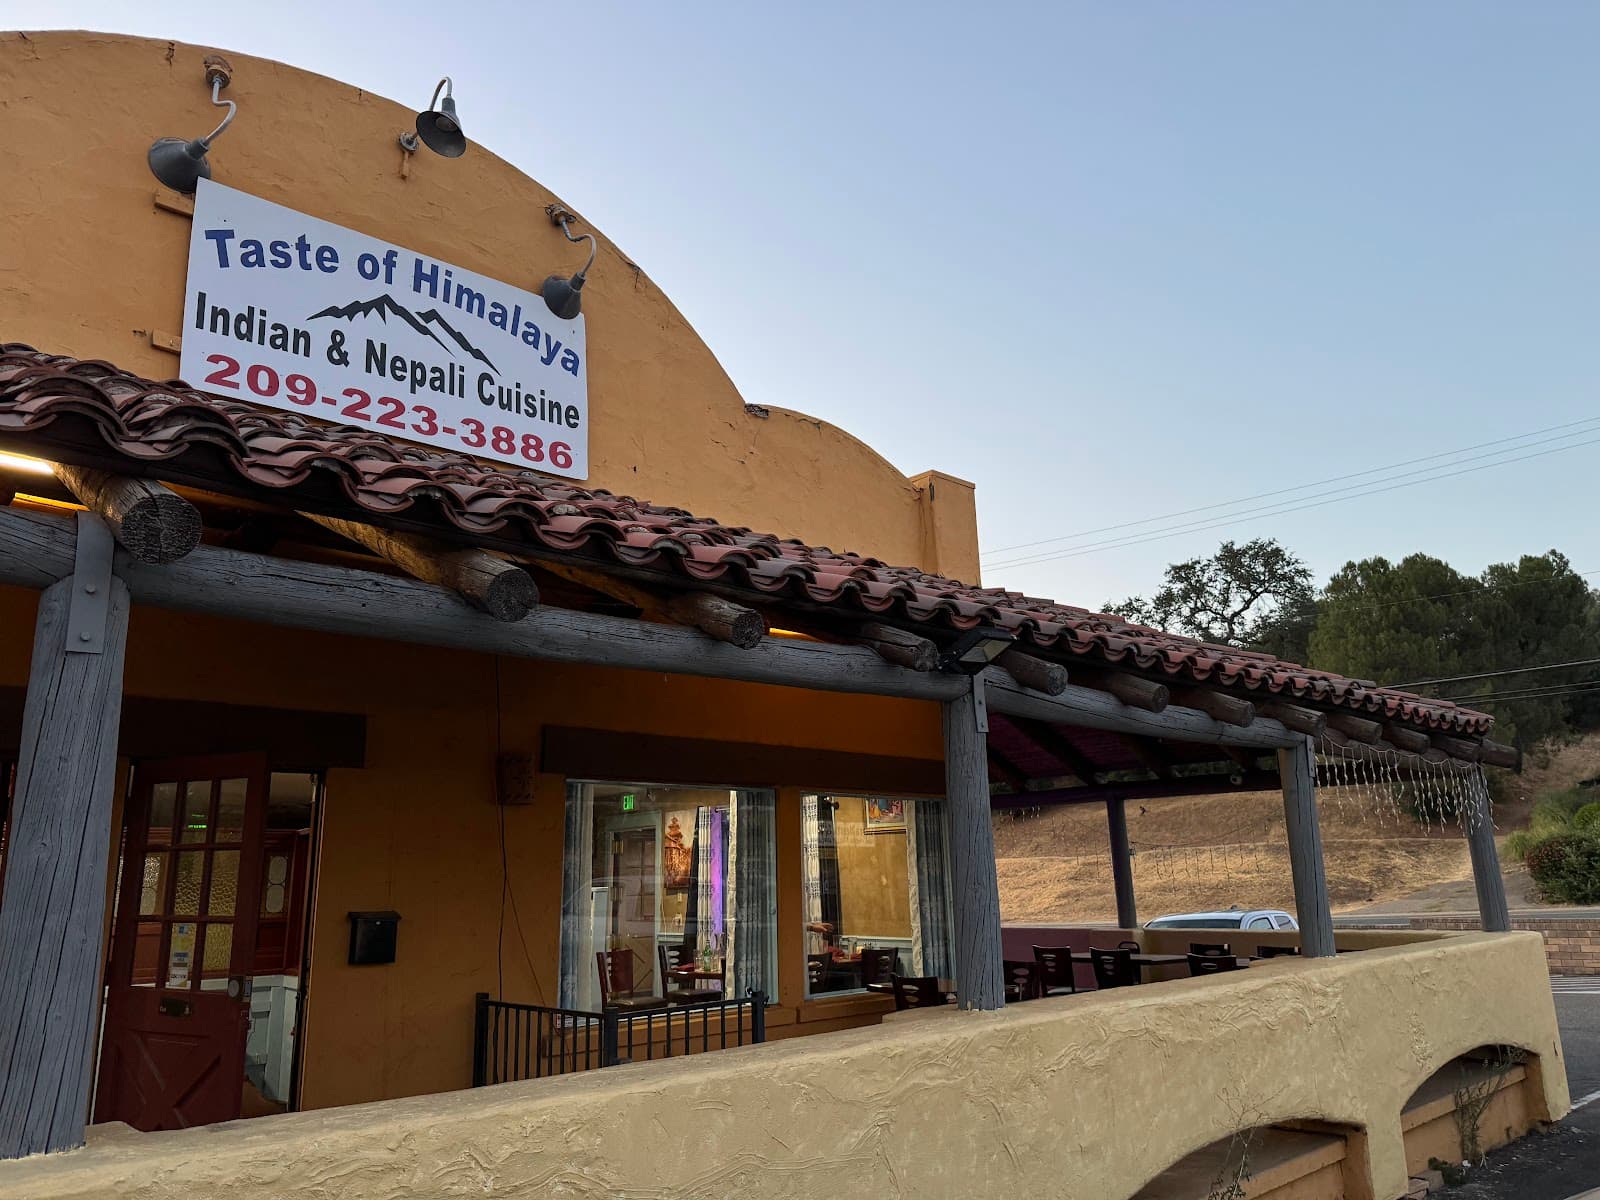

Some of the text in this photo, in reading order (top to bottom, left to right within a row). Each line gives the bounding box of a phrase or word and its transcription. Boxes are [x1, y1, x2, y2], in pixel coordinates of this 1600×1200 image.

[196, 291, 580, 429] Indian & Nepali Cuisine
[205, 229, 580, 377] Taste of Himalaya
[204, 354, 573, 469] 209-223-3886
